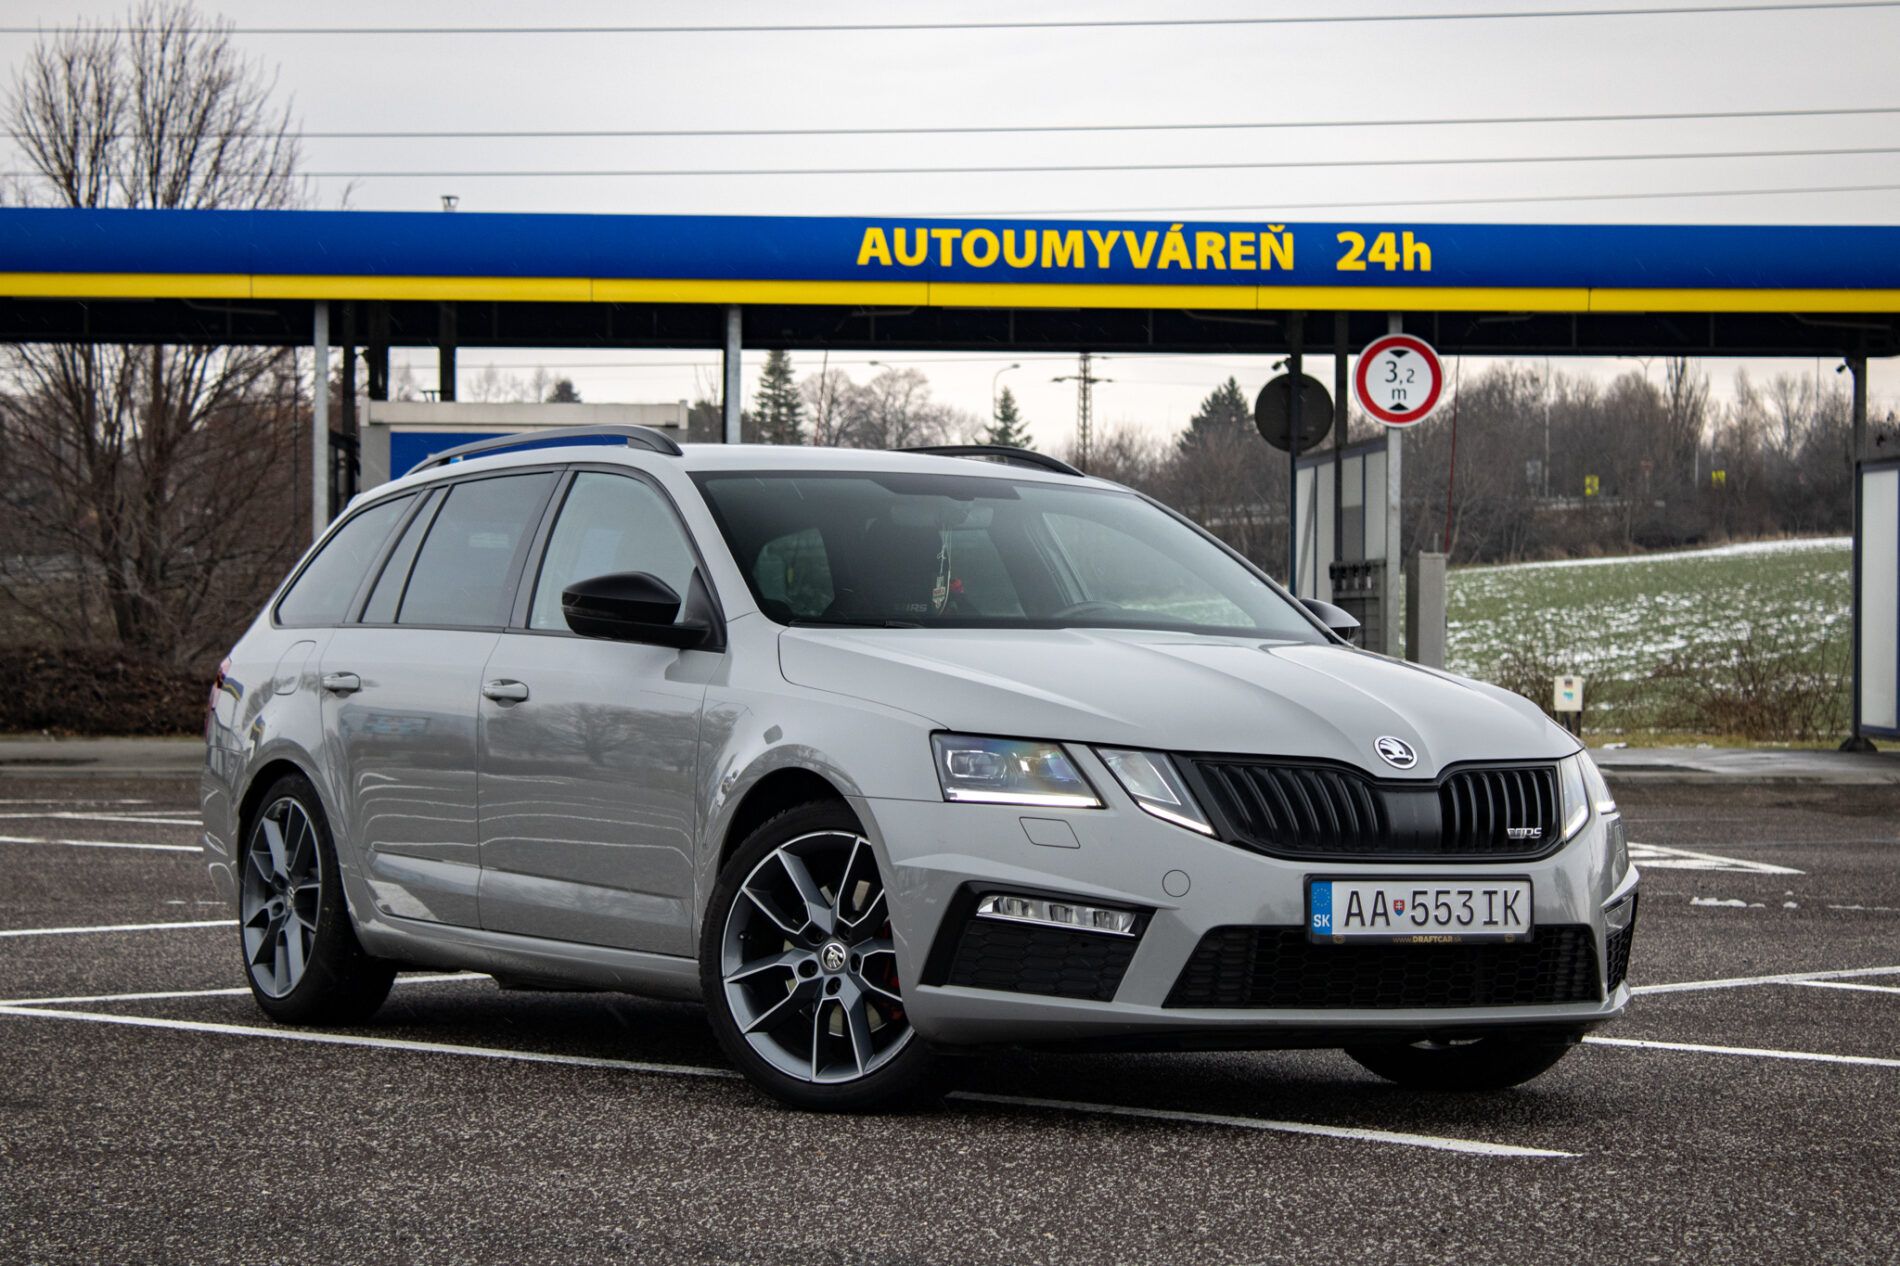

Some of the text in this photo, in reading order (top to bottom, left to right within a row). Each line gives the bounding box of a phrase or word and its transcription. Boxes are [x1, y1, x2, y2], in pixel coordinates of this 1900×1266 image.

[857, 223, 1431, 271] AUTOUMYVÁREŇ 24h
[1385, 360, 1415, 385] 3,2
[1391, 388, 1407, 400] m
[1344, 890, 1521, 926] AA 553IK
[1313, 914, 1330, 928] SK
